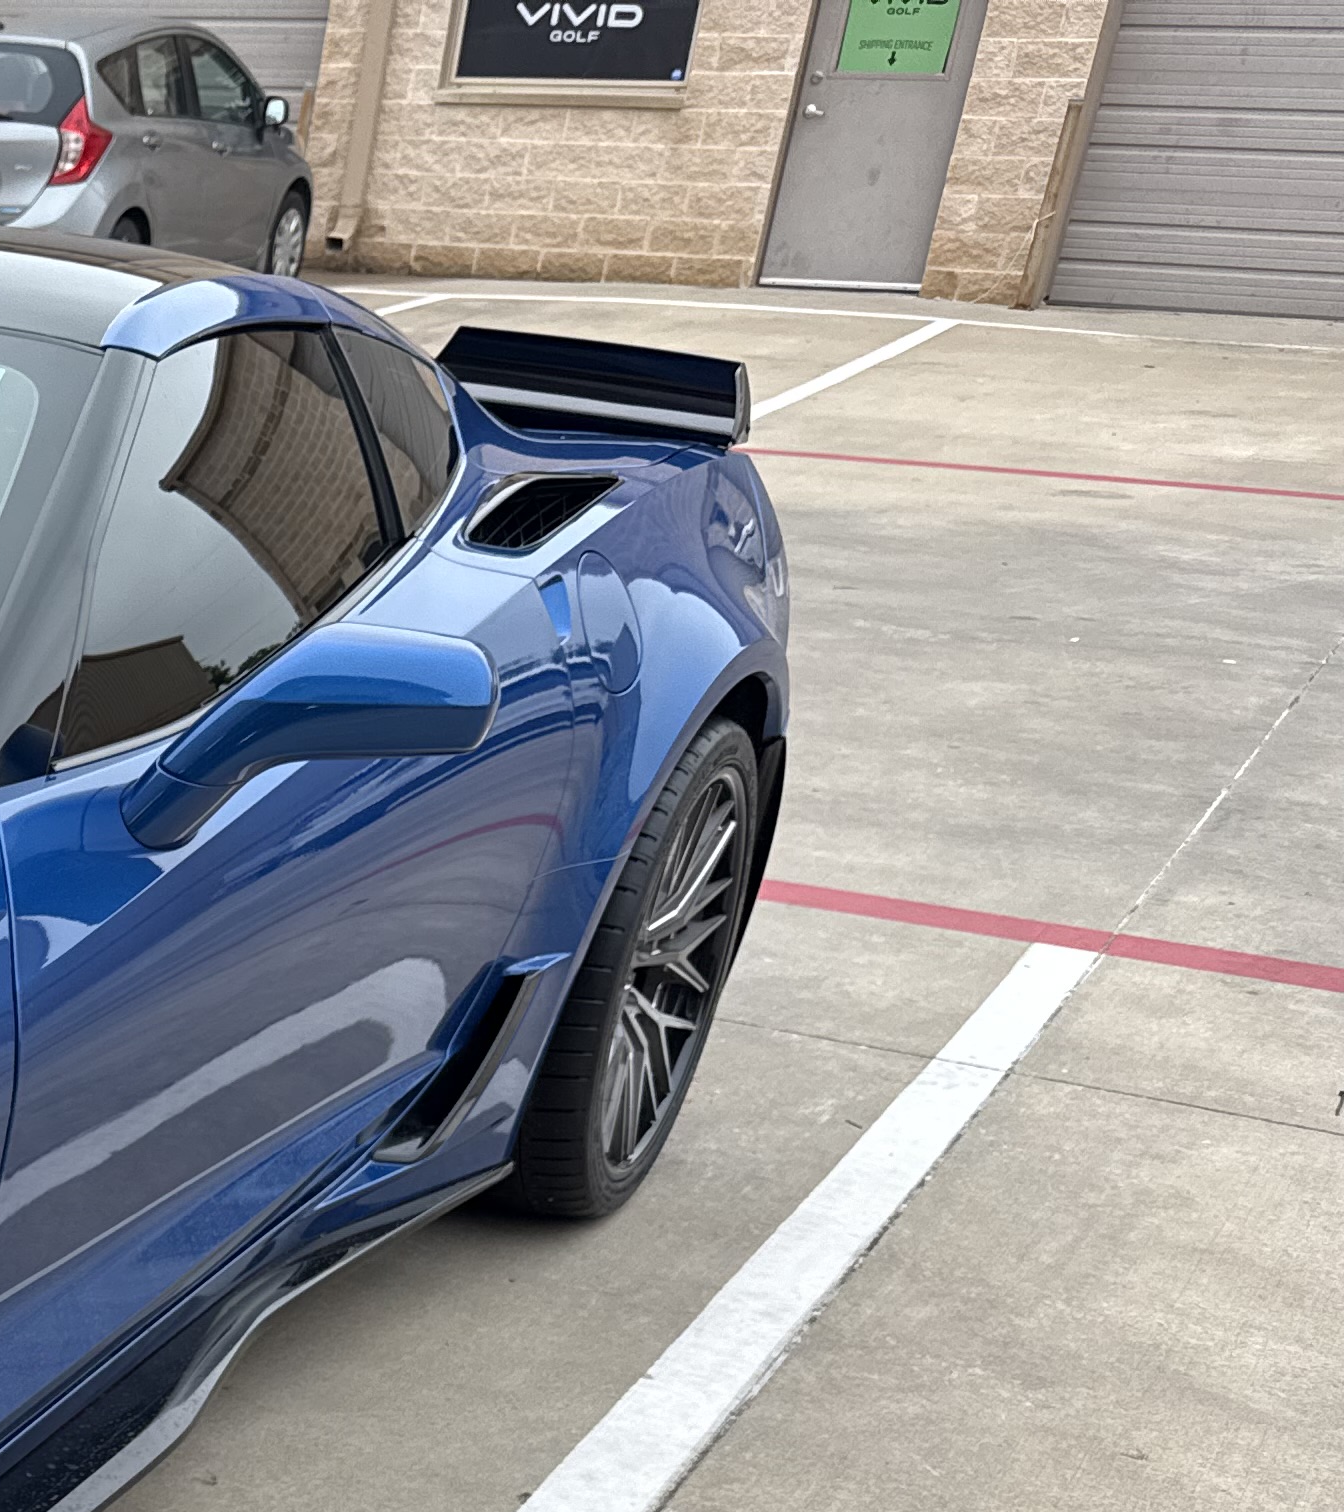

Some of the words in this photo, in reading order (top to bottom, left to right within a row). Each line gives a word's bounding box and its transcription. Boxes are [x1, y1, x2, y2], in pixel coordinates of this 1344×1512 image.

[516, 2, 644, 28] VIVID
[886, 7, 921, 16] GOLF
[549, 29, 601, 43] GOLF
[893, 39, 934, 51] ENTRANCE
